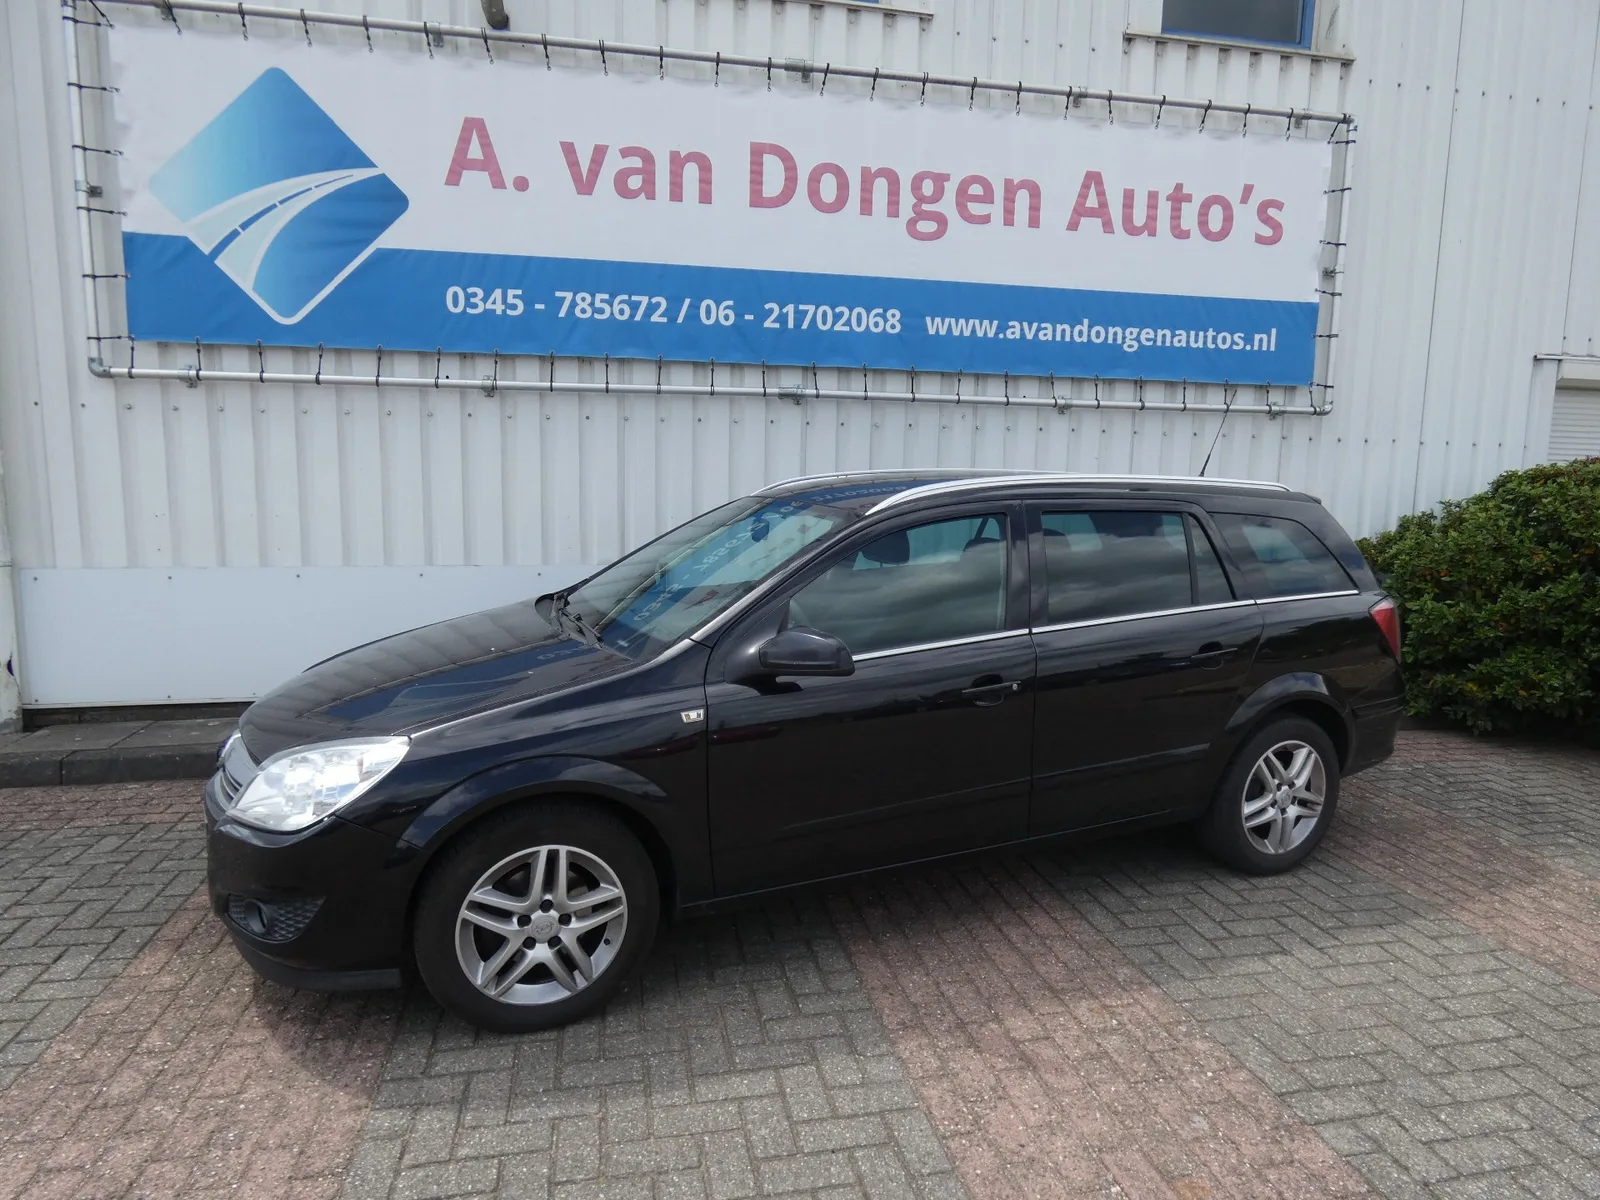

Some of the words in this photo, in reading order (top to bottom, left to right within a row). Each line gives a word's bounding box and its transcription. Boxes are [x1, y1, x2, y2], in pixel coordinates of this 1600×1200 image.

[444, 116, 530, 193] A.
[558, 140, 713, 206] van
[748, 141, 1042, 242] Dongen
[445, 285, 524, 317] 0345
[554, 290, 668, 324] 785672
[676, 297, 691, 325] /
[699, 298, 736, 327] 06
[763, 301, 902, 335] 21702068
[925, 314, 1278, 354] www.avandongenautos.nl
